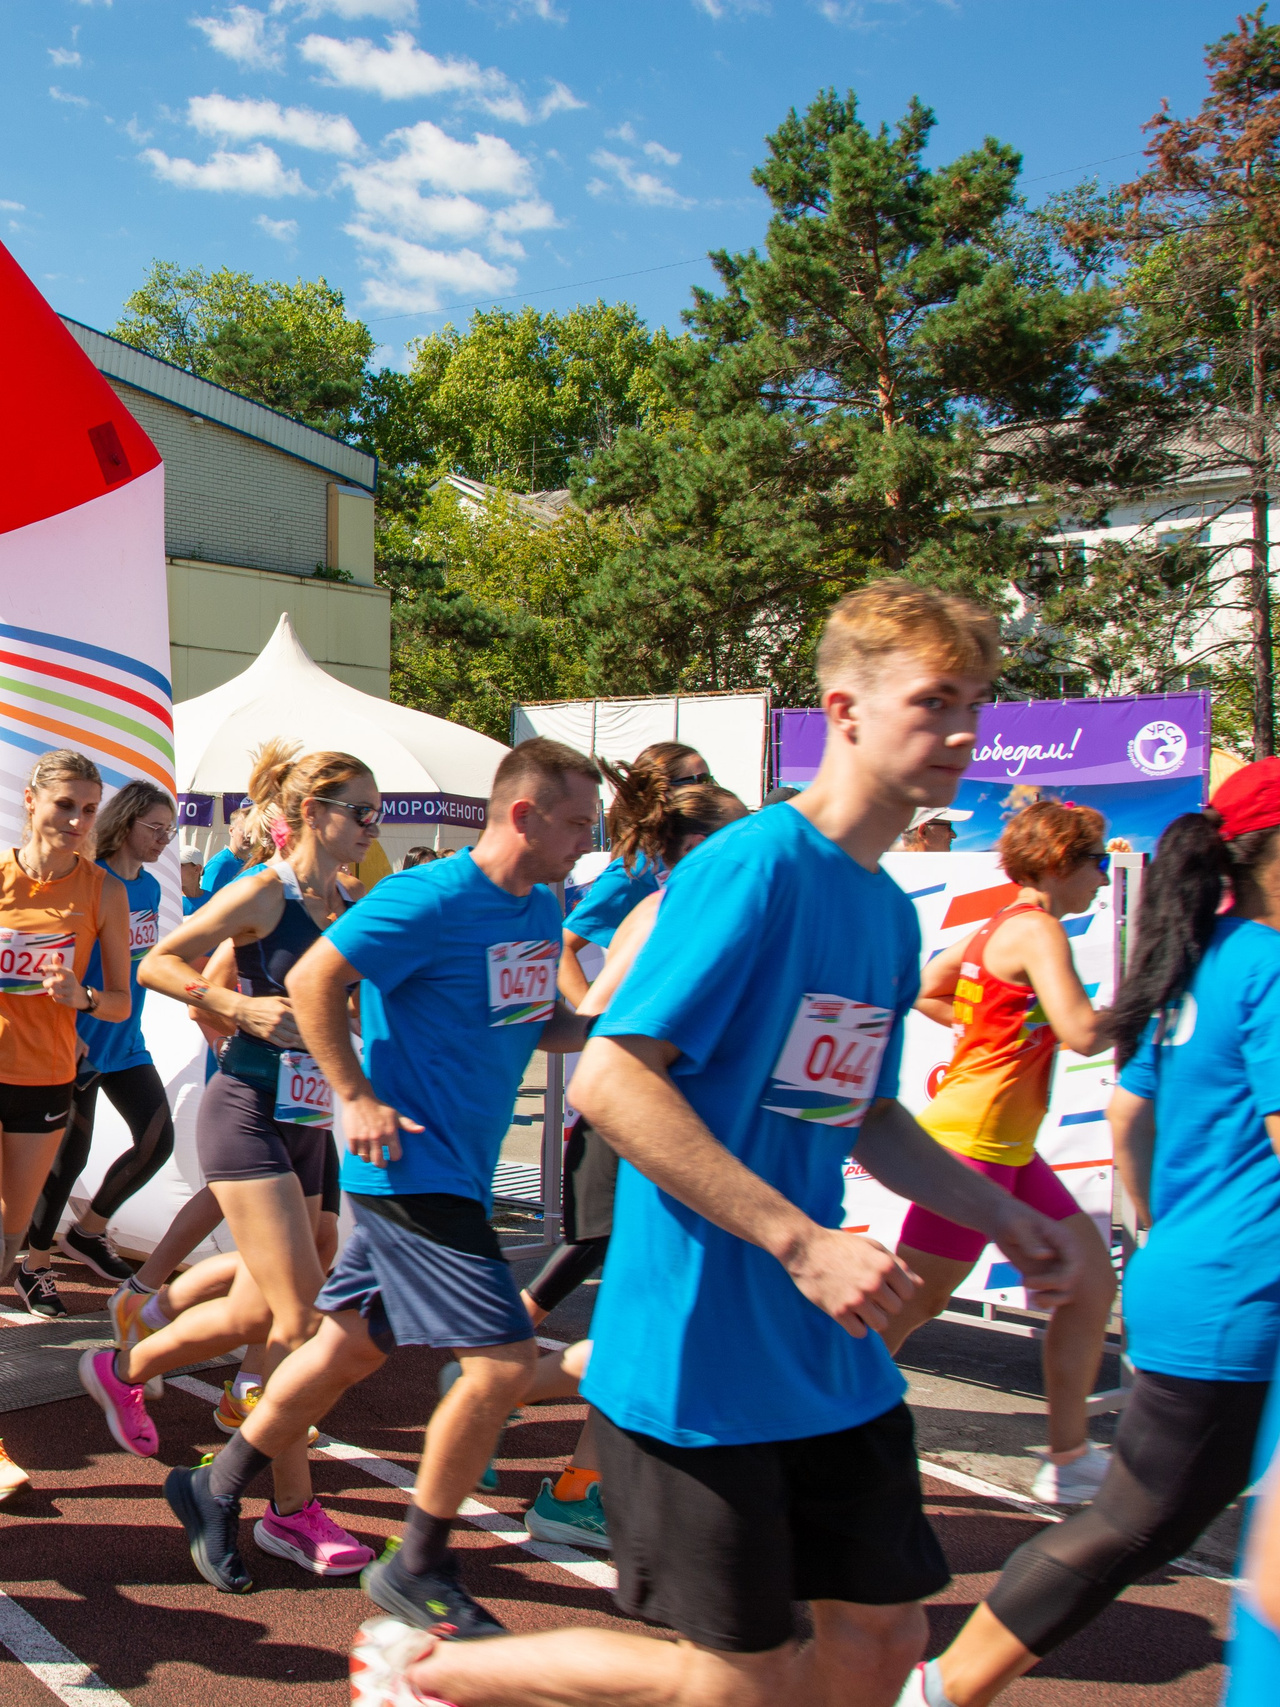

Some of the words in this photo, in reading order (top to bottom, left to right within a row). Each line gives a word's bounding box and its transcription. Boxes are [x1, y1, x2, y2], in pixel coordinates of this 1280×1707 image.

[1146, 723, 1183, 745] УРСА
[382, 800, 485, 822] МОРОЖЕНОГО
[499, 965, 548, 999] 0479
